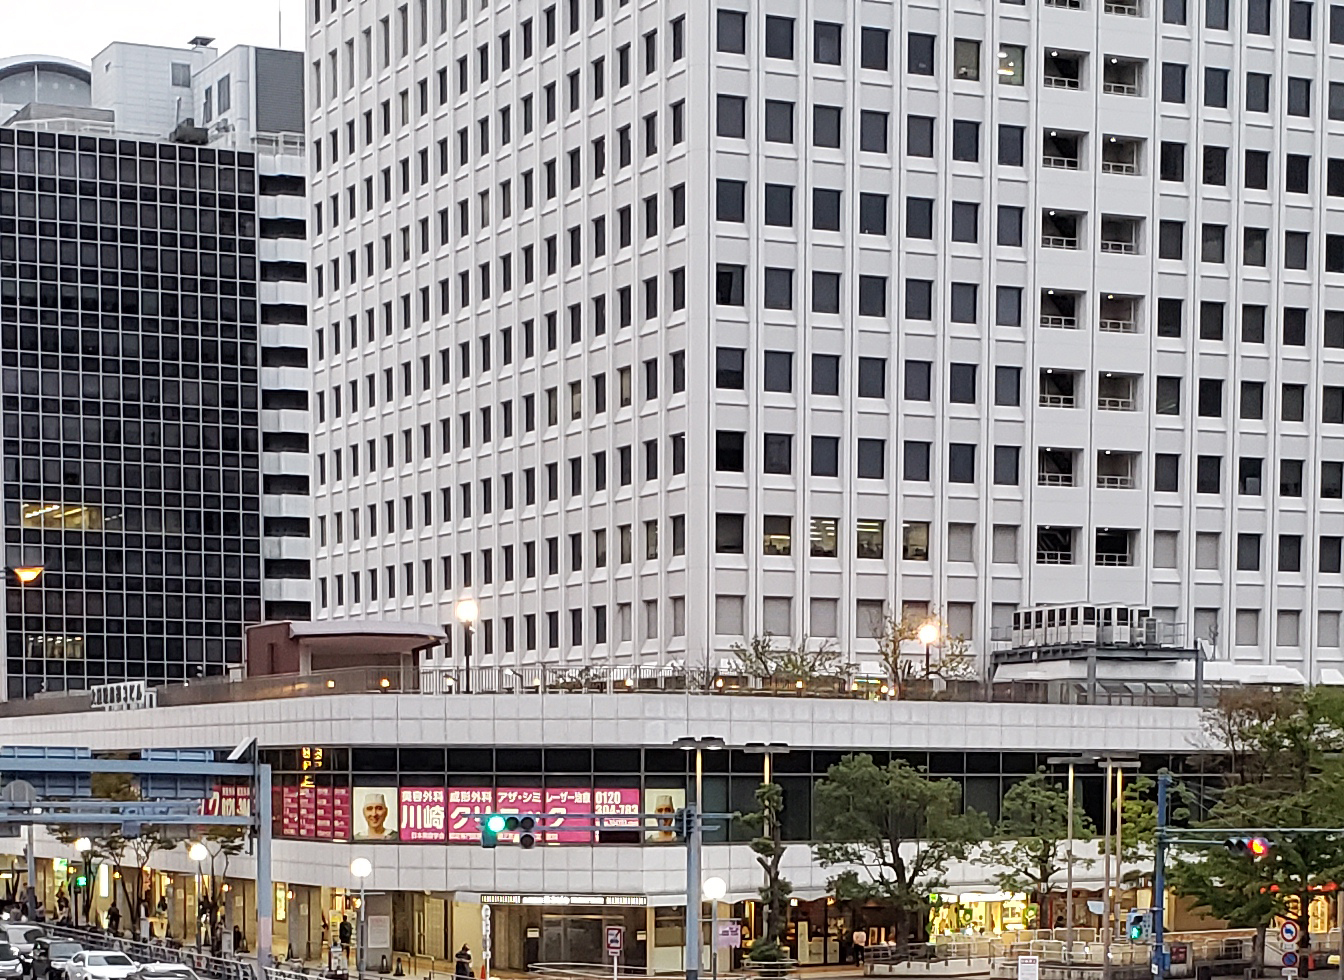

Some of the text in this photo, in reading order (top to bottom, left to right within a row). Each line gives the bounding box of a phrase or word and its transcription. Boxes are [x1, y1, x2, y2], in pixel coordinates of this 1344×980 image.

[497, 791, 542, 803] アザ・シミ
[595, 791, 621, 804] 0120
